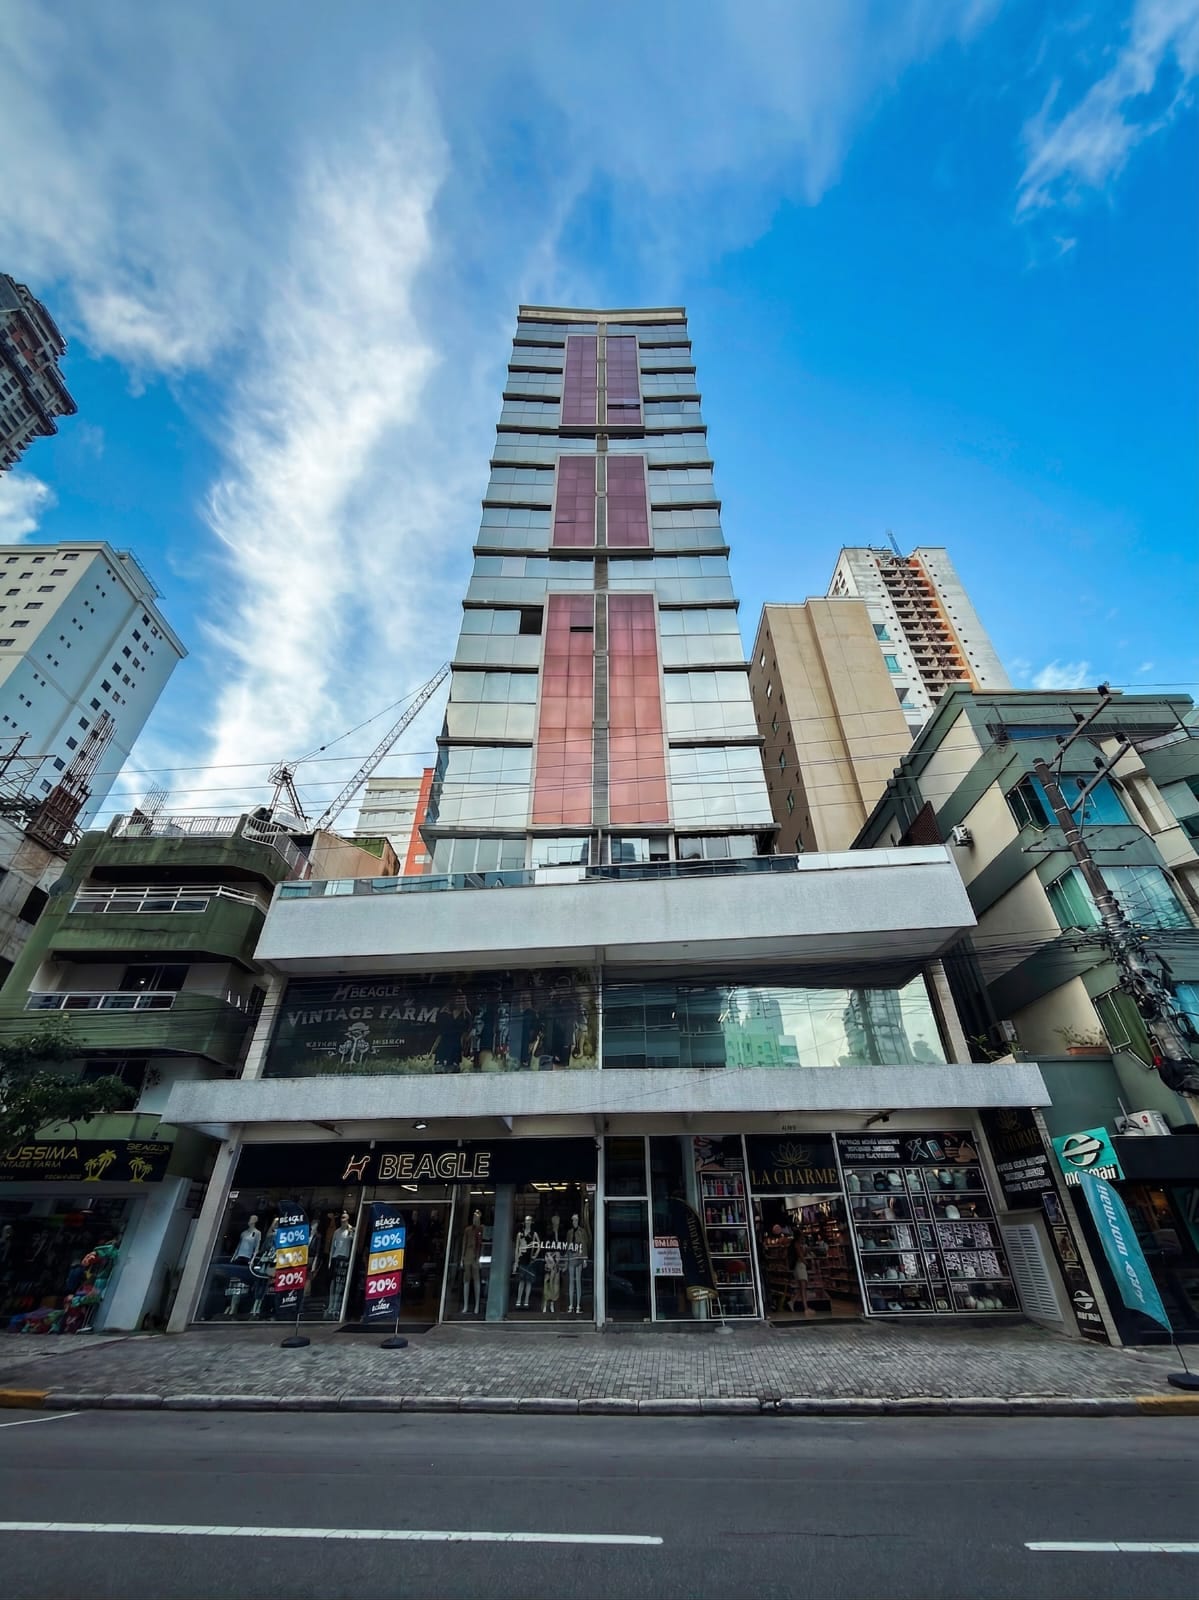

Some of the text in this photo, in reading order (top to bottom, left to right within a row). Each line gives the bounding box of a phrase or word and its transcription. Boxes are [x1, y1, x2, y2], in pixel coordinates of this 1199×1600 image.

[350, 986, 400, 999] BEAGLE
[288, 1005, 440, 1027] VINTAGE FARM
[0, 1160, 61, 1169] NTAGE FARM
[378, 1152, 491, 1180] BEAGLE
[751, 1167, 838, 1186] LA CHARME
[1064, 1163, 1117, 1187] momaii
[1096, 1184, 1128, 1257] mormaii
[279, 1229, 305, 1244] 50%
[373, 1232, 402, 1248] 50%
[277, 1271, 304, 1287] 20%
[368, 1277, 397, 1294] 20%
